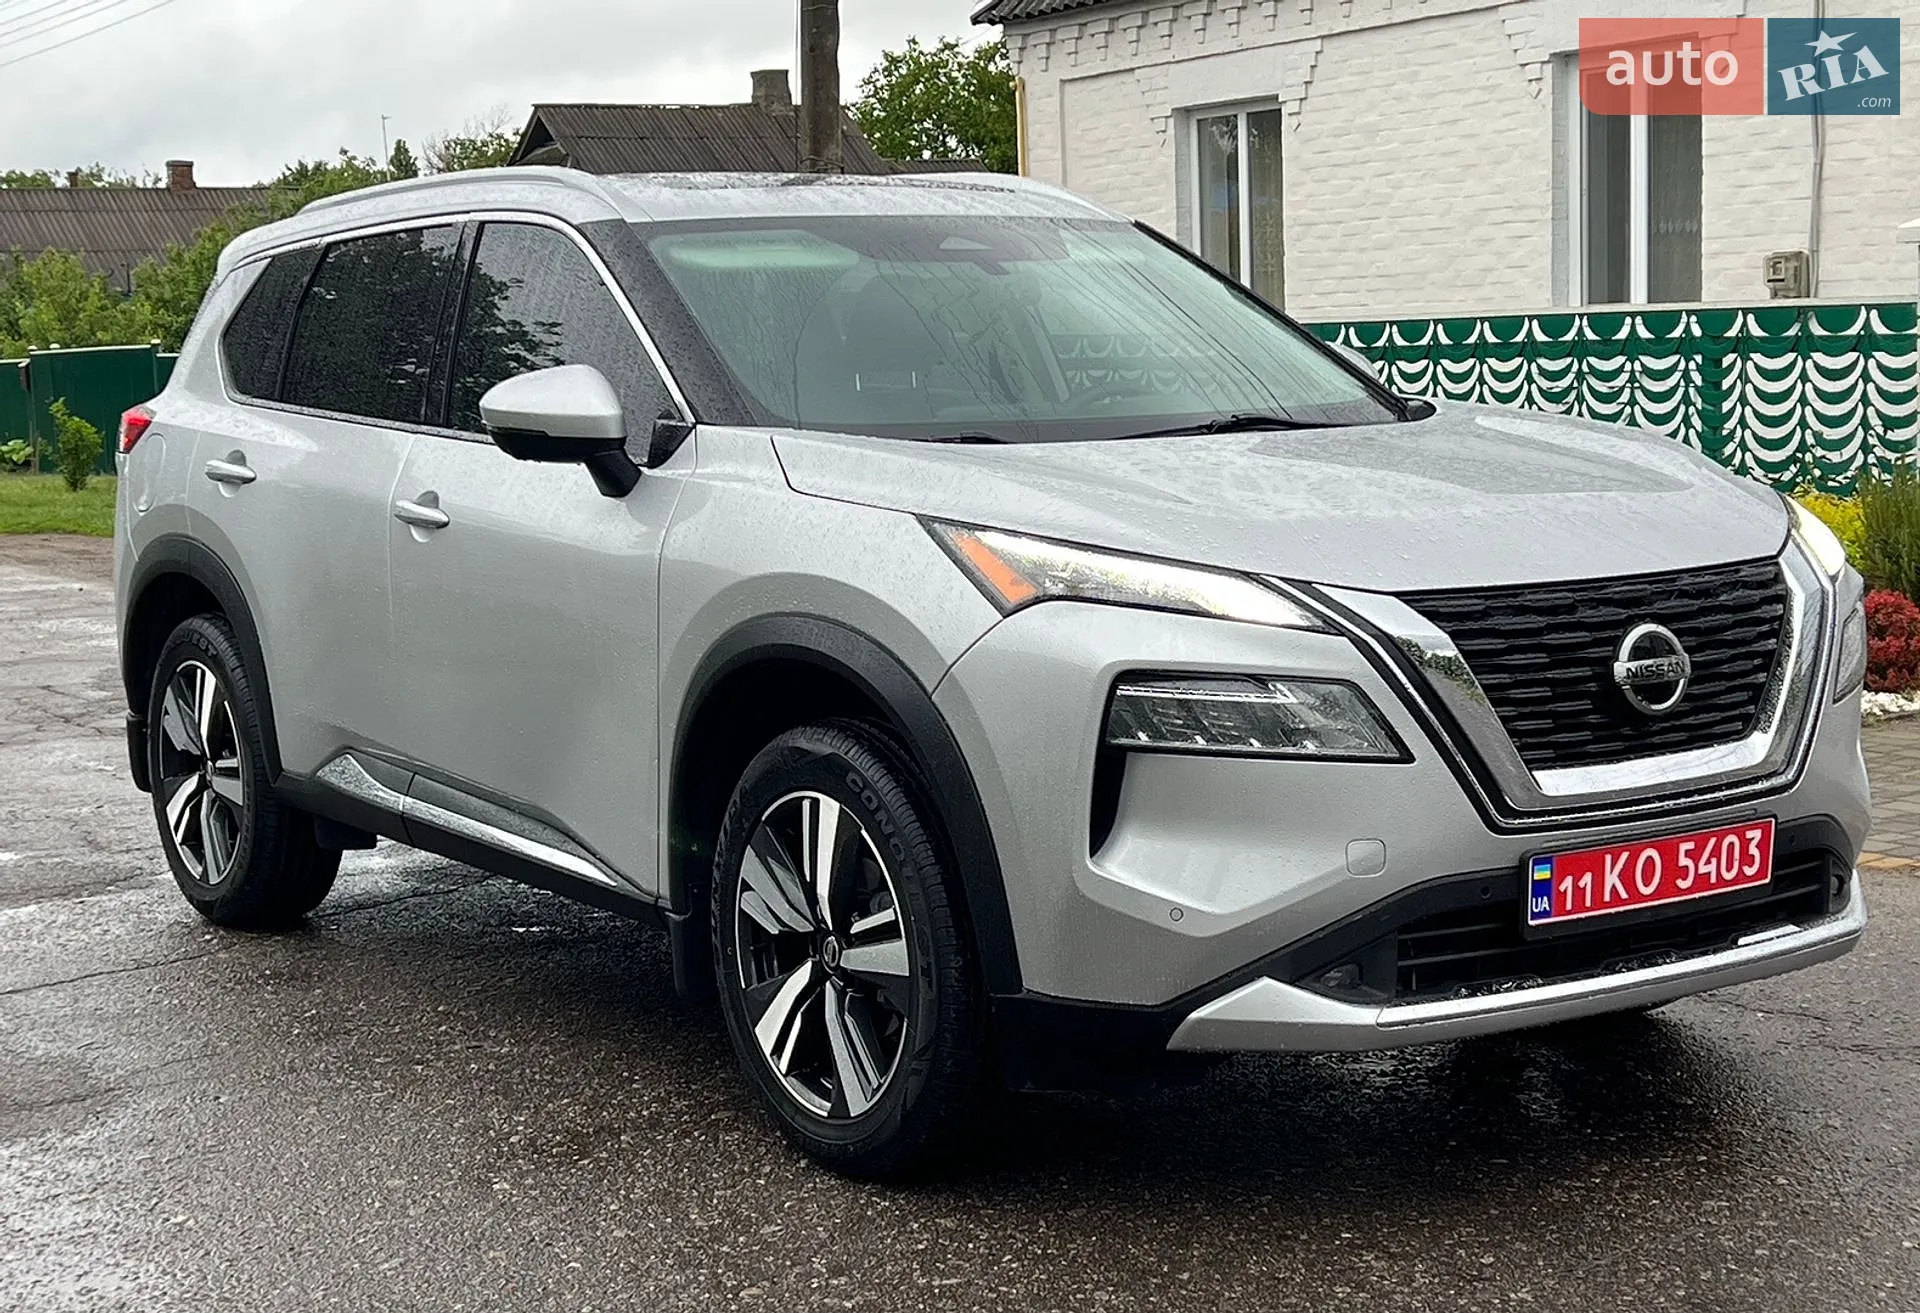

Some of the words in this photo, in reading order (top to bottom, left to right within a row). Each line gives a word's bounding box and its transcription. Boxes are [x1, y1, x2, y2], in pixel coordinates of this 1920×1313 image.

[1624, 660, 1686, 680] NISSAN
[1558, 871, 1593, 911] 11
[1603, 847, 1663, 902] KO
[1675, 828, 1763, 890] 5403
[1531, 895, 1551, 913] UA
